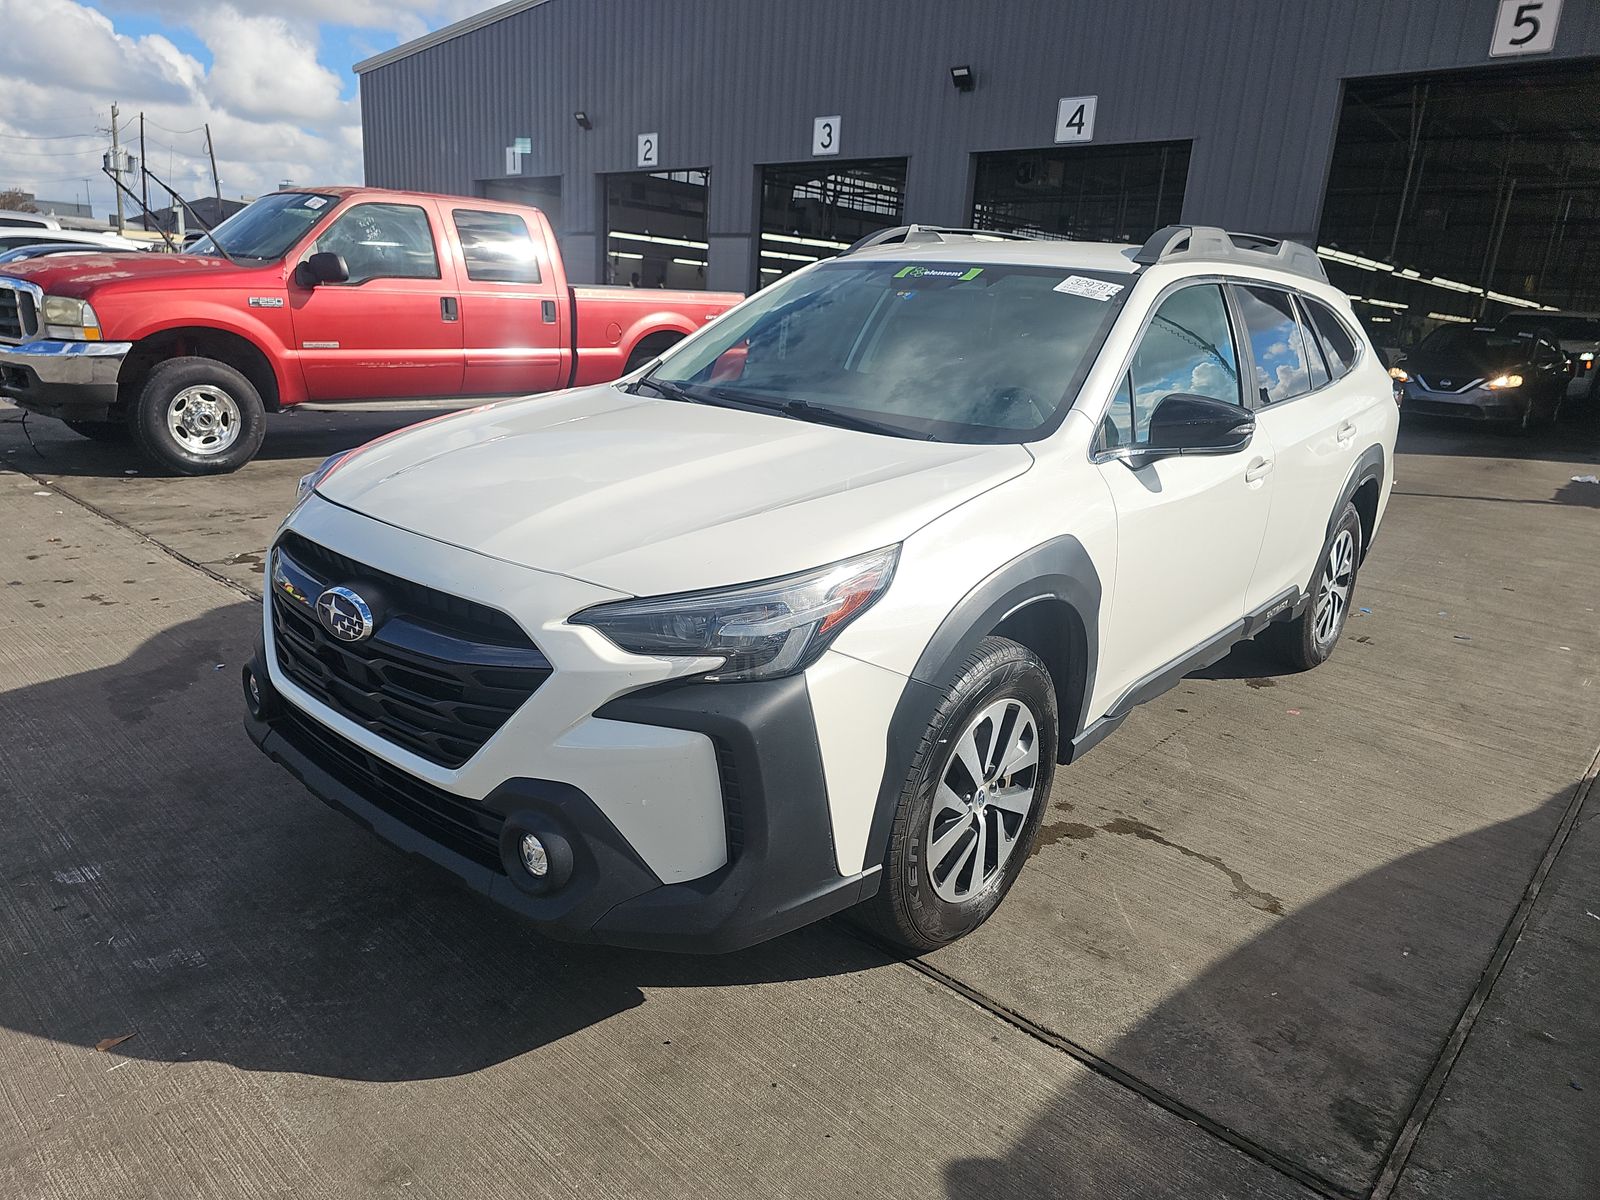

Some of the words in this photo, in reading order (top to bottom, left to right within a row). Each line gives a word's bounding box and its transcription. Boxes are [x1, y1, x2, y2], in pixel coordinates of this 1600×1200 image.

[1508, 3, 1544, 46] 5
[1065, 104, 1085, 135] 4
[820, 122, 832, 149] 3
[643, 139, 653, 161] 2
[924, 269, 963, 277] element
